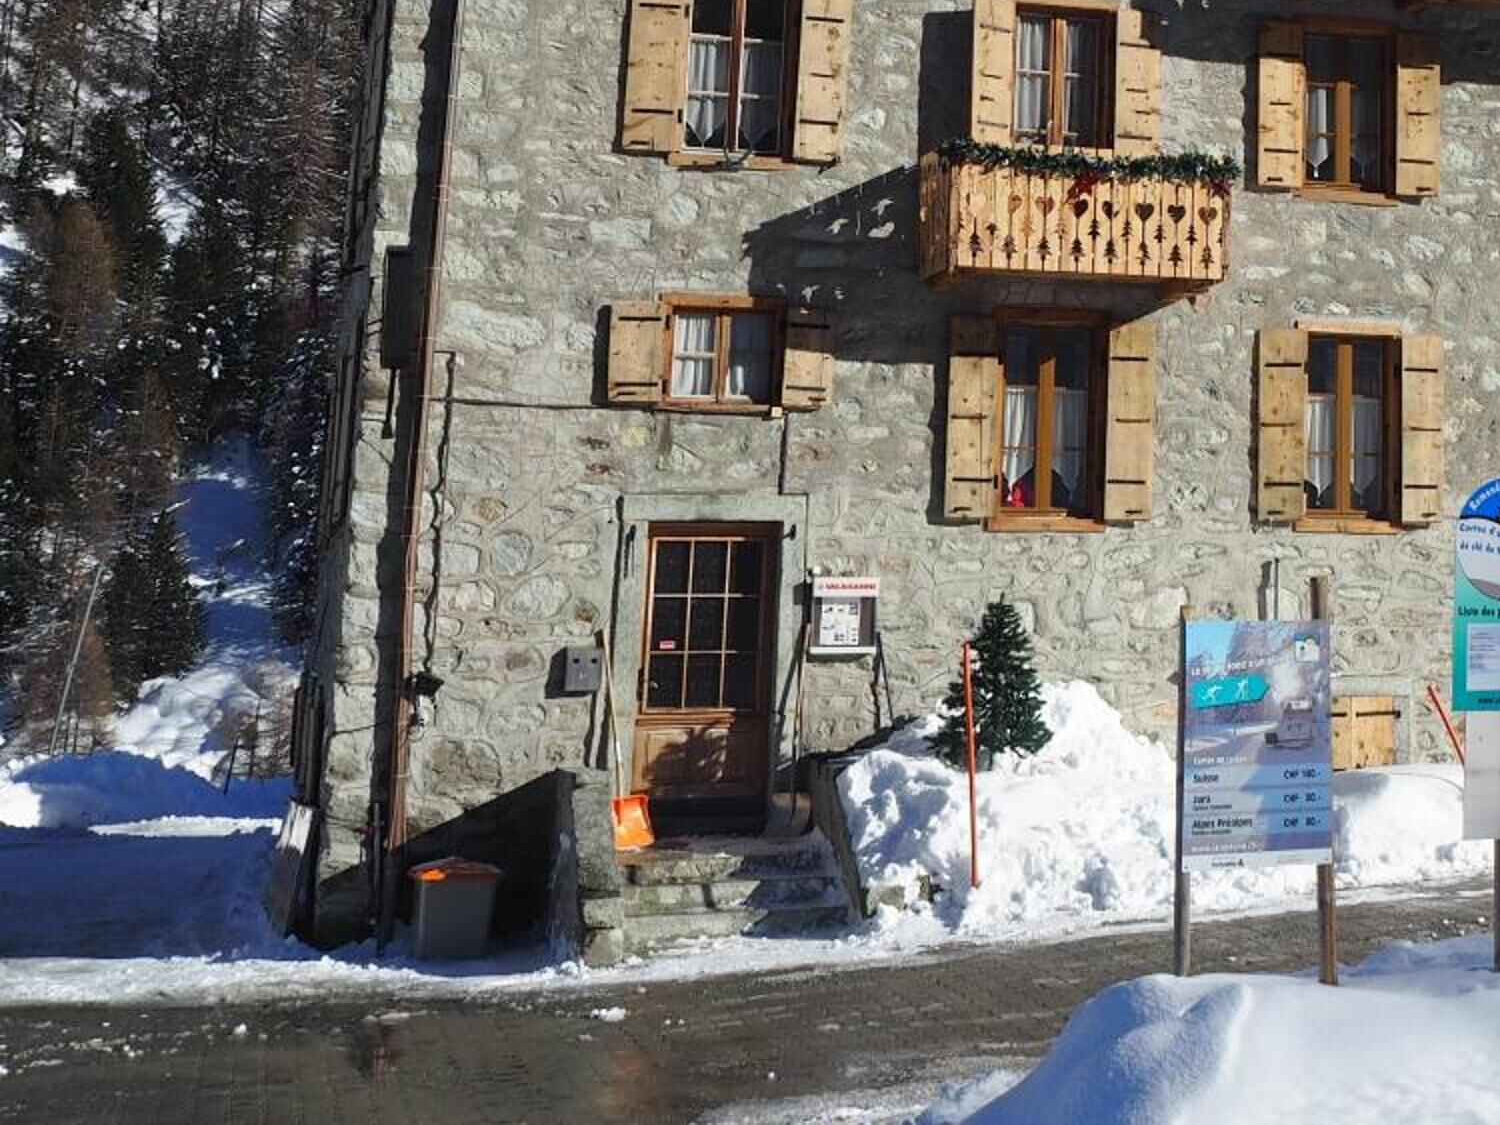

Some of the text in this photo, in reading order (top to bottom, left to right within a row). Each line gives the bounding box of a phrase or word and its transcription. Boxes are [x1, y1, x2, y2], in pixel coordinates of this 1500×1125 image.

[1459, 541, 1469, 550] de
[1485, 542, 1495, 553] de
[1458, 606, 1479, 616] Liste
[1481, 605, 1495, 616] des
[1193, 773, 1219, 783] Suisse
[1283, 768, 1299, 780] CHF
[1283, 792, 1299, 804] CHF
[1193, 819, 1215, 829] Alpes
[1283, 817, 1299, 828] CHF
